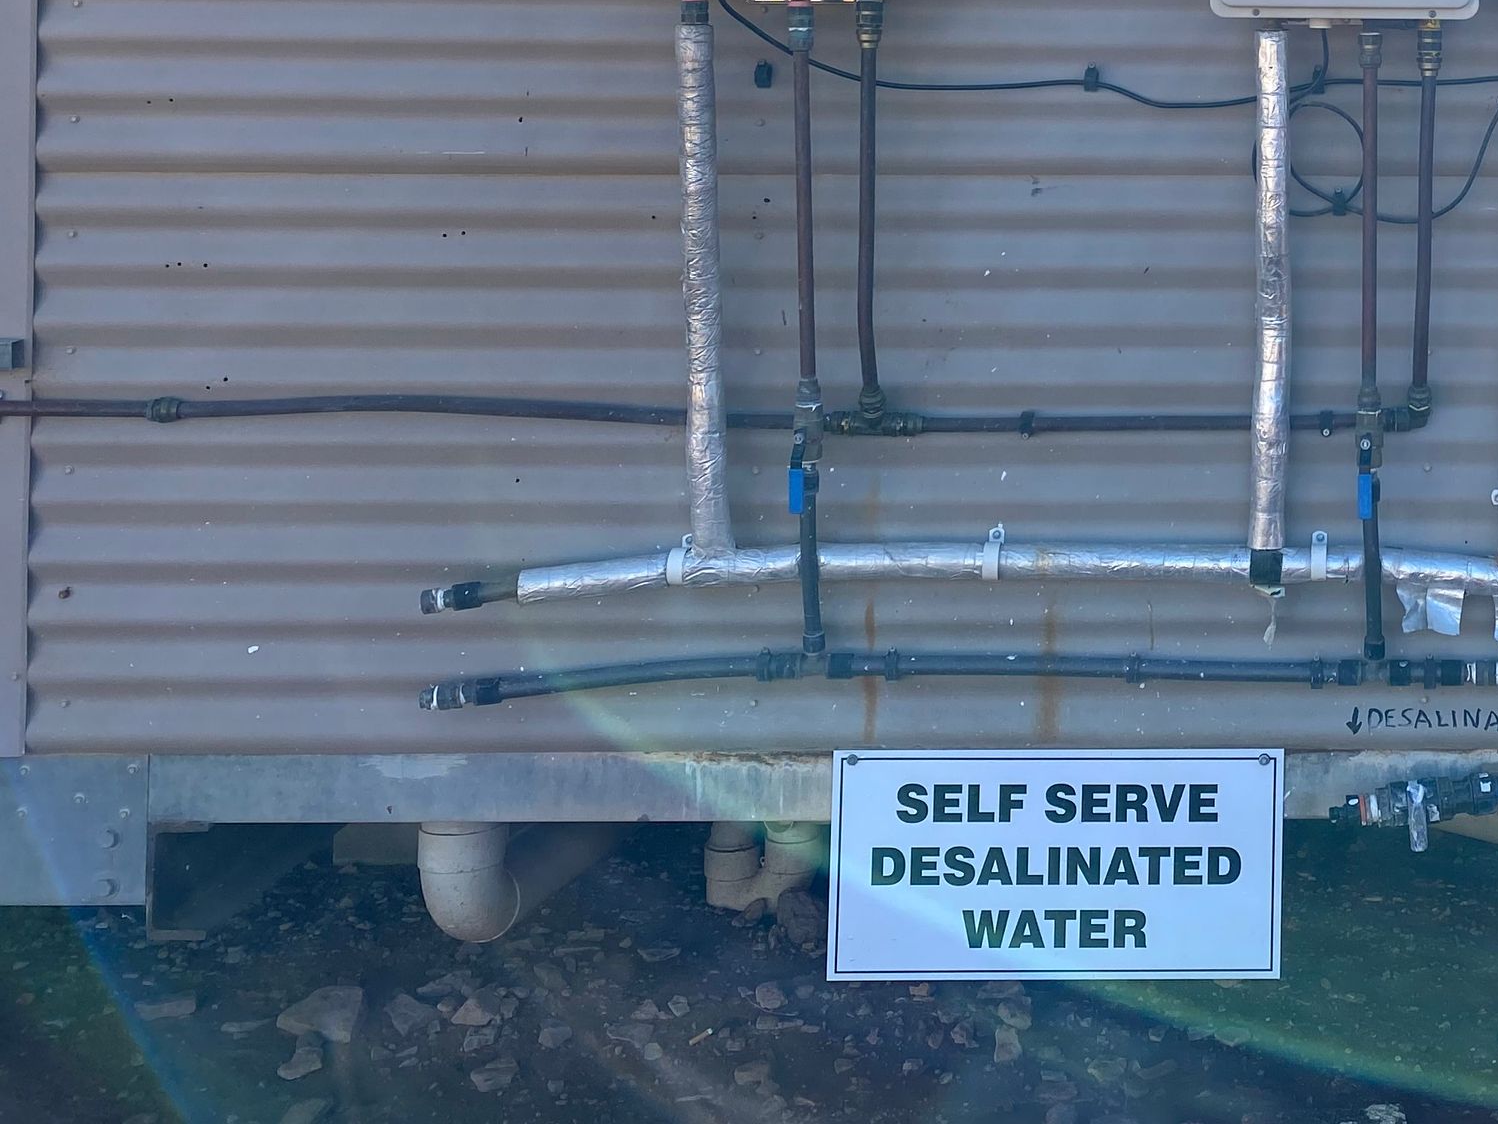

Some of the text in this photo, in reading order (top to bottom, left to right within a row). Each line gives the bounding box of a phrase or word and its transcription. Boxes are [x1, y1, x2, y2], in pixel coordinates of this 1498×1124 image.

[896, 783, 1219, 823] SELF SERVE
[870, 846, 1242, 886] DESALINATED
[962, 909, 1148, 949] WATER
